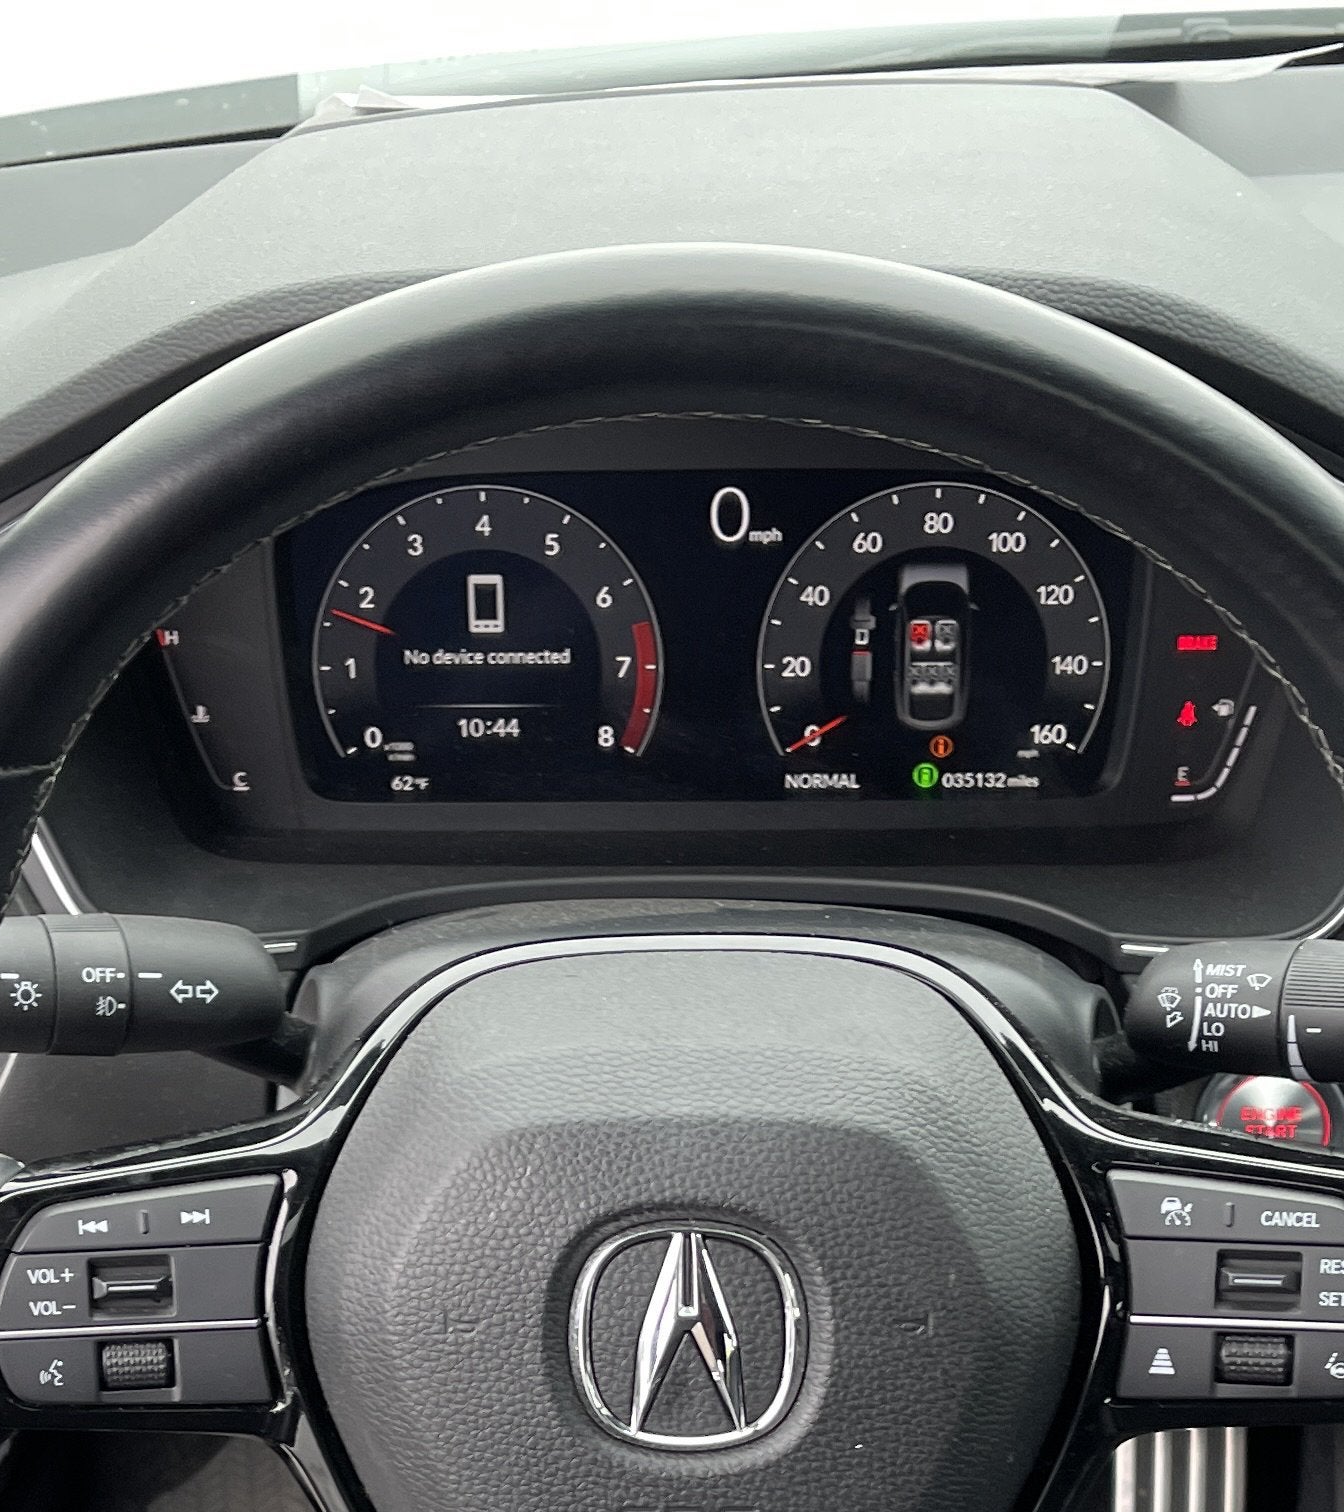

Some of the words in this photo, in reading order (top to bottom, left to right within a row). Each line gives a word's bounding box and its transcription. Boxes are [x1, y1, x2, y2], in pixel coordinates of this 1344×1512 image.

[475, 515, 492, 537] 4
[710, 486, 750, 543] 0
[749, 528, 783, 545] mph
[923, 512, 954, 533] 80
[407, 534, 424, 556] 3
[544, 534, 560, 556] 5
[852, 532, 883, 553] 60
[988, 532, 1026, 553] 100
[359, 588, 375, 609] 2
[596, 587, 613, 608] 6
[800, 585, 830, 606] 40
[1037, 584, 1074, 605] 120
[404, 649, 430, 665] No
[434, 649, 484, 665] device
[487, 649, 571, 665] connected
[615, 657, 632, 678] 7
[782, 656, 811, 677] 20
[1052, 655, 1088, 675] 140
[345, 658, 357, 679] 1
[364, 727, 383, 748] 0
[458, 718, 520, 738] 10:44
[597, 726, 615, 748] 8
[1030, 723, 1067, 745] 160
[784, 773, 860, 789] NORMAL
[941, 773, 1006, 788] 035132
[81, 967, 116, 983] OFF
[1206, 965, 1247, 977] MIST
[1205, 984, 1238, 998] OFF
[1204, 1003, 1251, 1019] AUTO
[1203, 1022, 1225, 1037] LO
[1201, 1040, 1219, 1053] HI
[1260, 1211, 1320, 1228] CANCEL
[27, 1268, 74, 1284] VOL+
